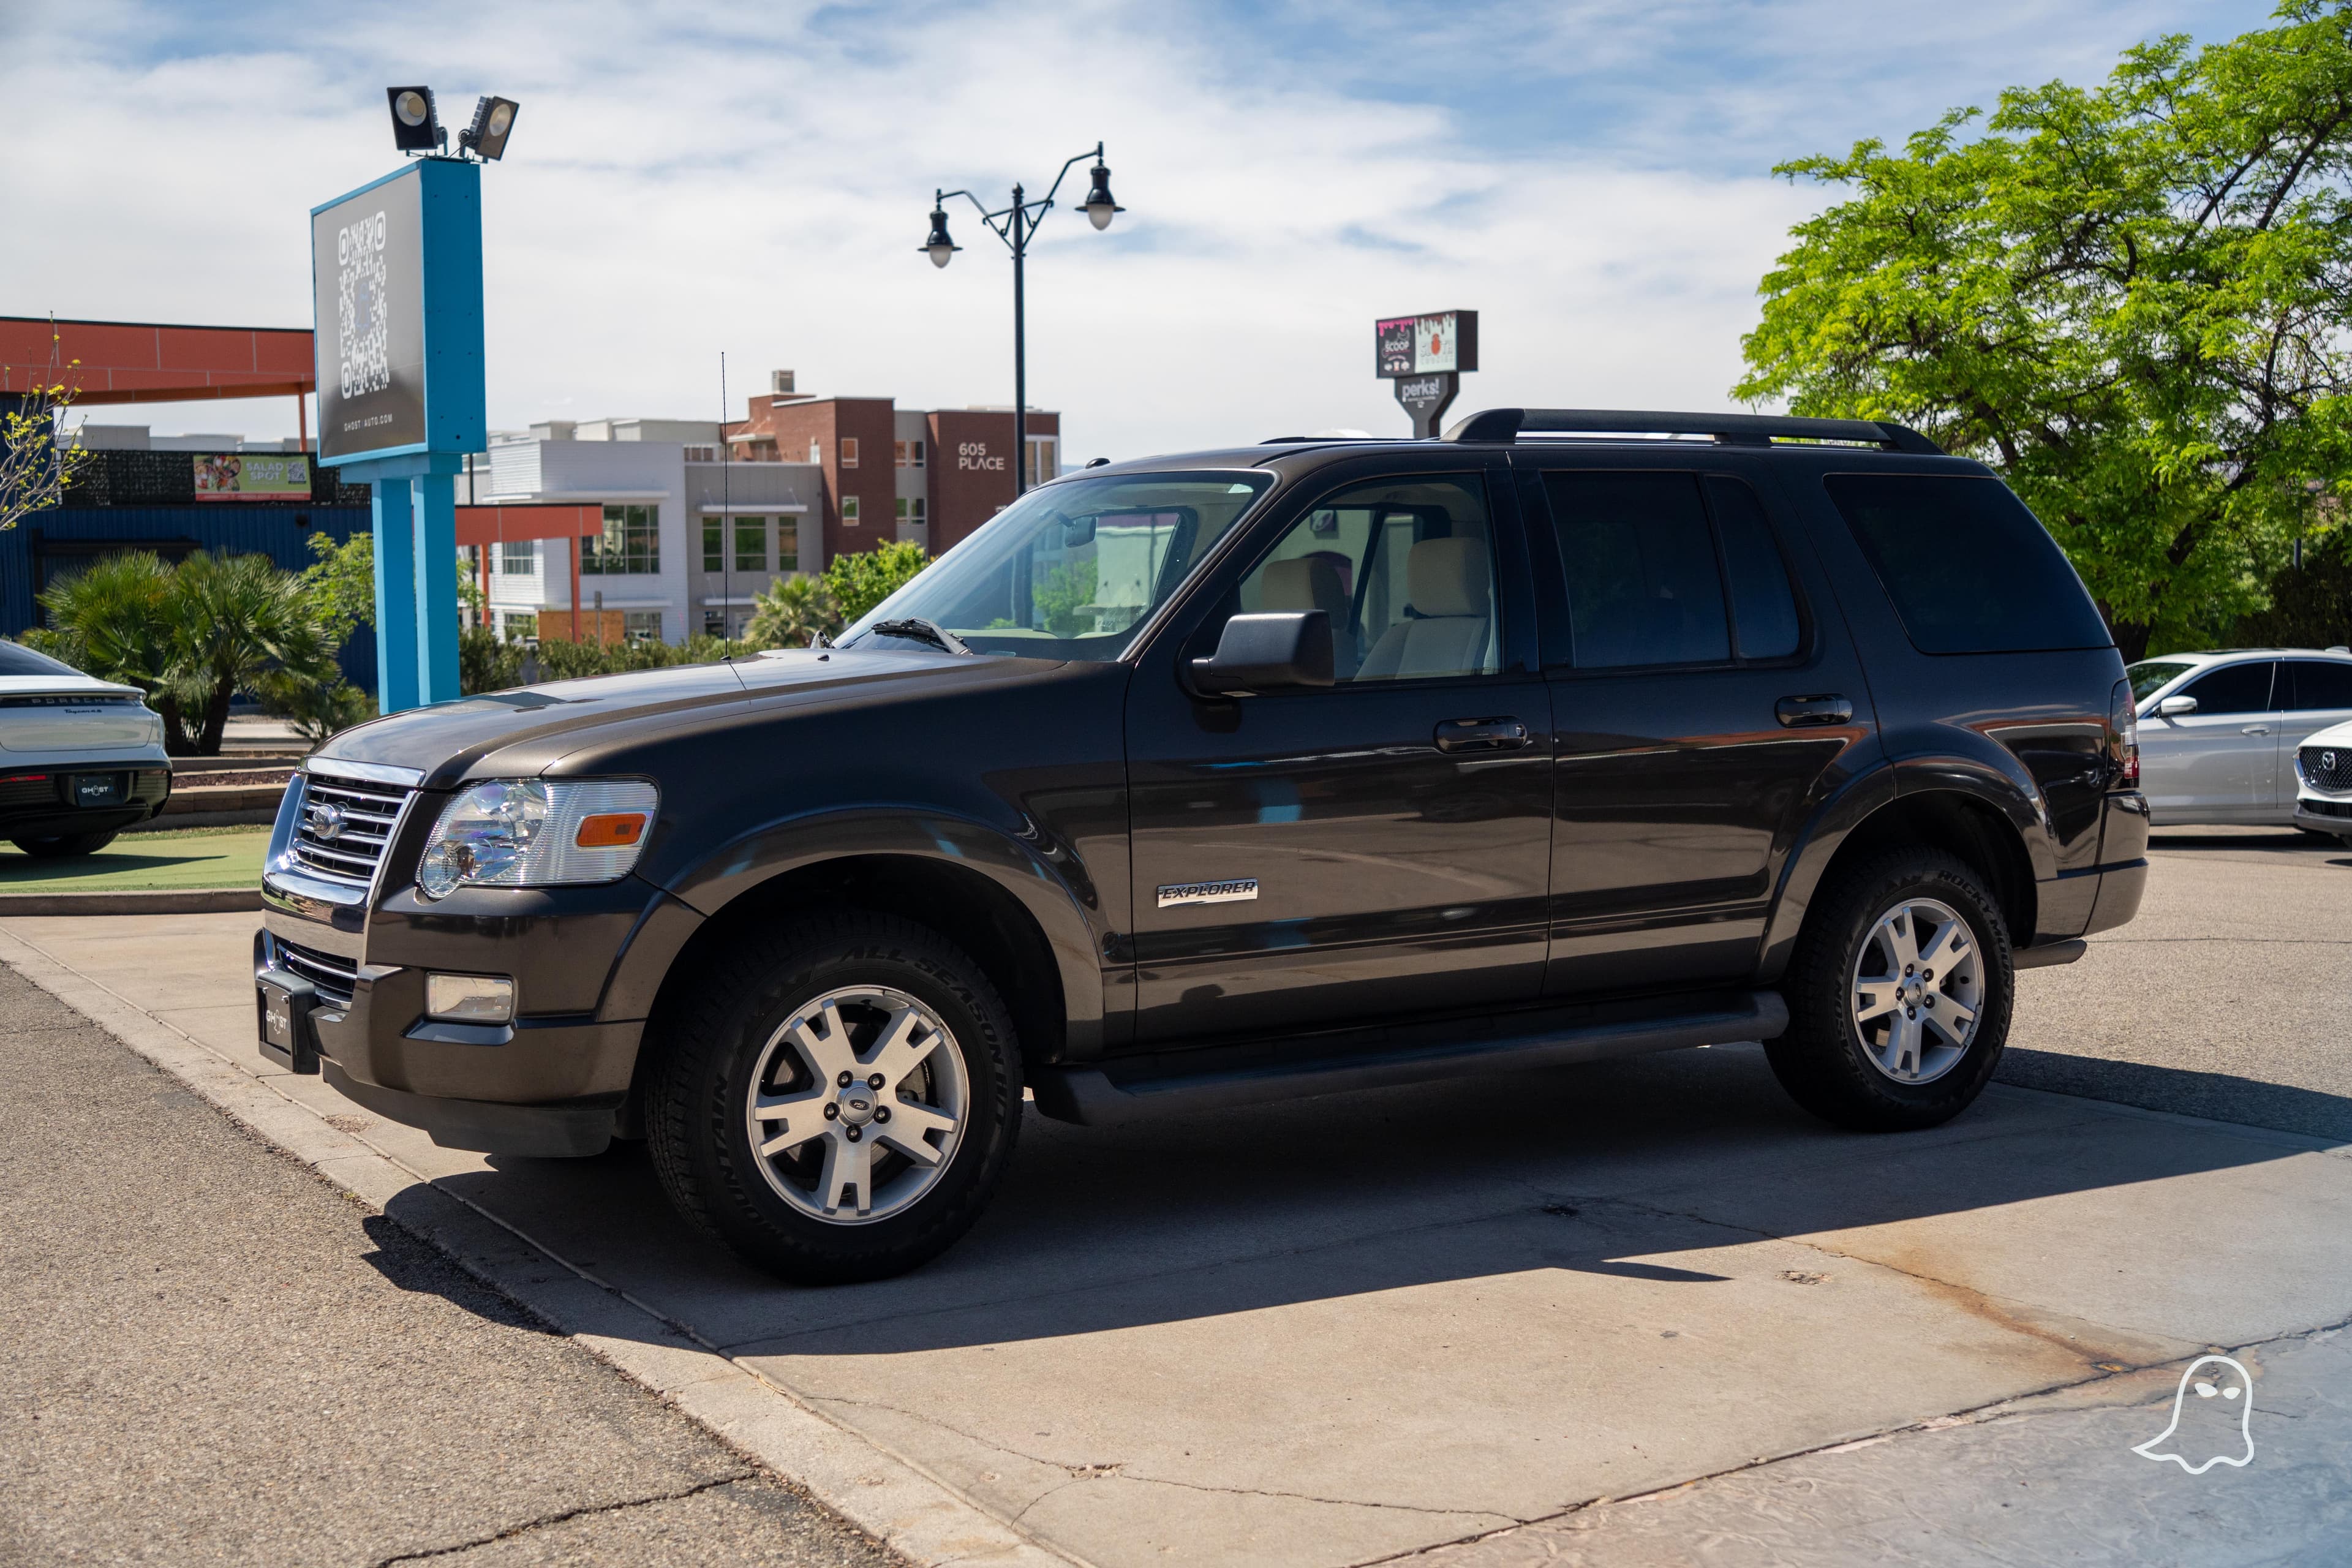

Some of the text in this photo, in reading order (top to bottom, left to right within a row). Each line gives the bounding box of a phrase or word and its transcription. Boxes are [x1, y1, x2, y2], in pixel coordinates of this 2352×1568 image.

[1402, 377, 1439, 402] perks!
[959, 442, 986, 456] 605
[246, 462, 284, 471] SALAD
[959, 457, 1005, 470] PLACE
[250, 471, 281, 481] SPOT
[1162, 881, 1256, 900] EXPLORER
[1937, 869, 1993, 914] ROCKY
[840, 945, 908, 963] ALL
[913, 957, 1005, 1065] SEASON
